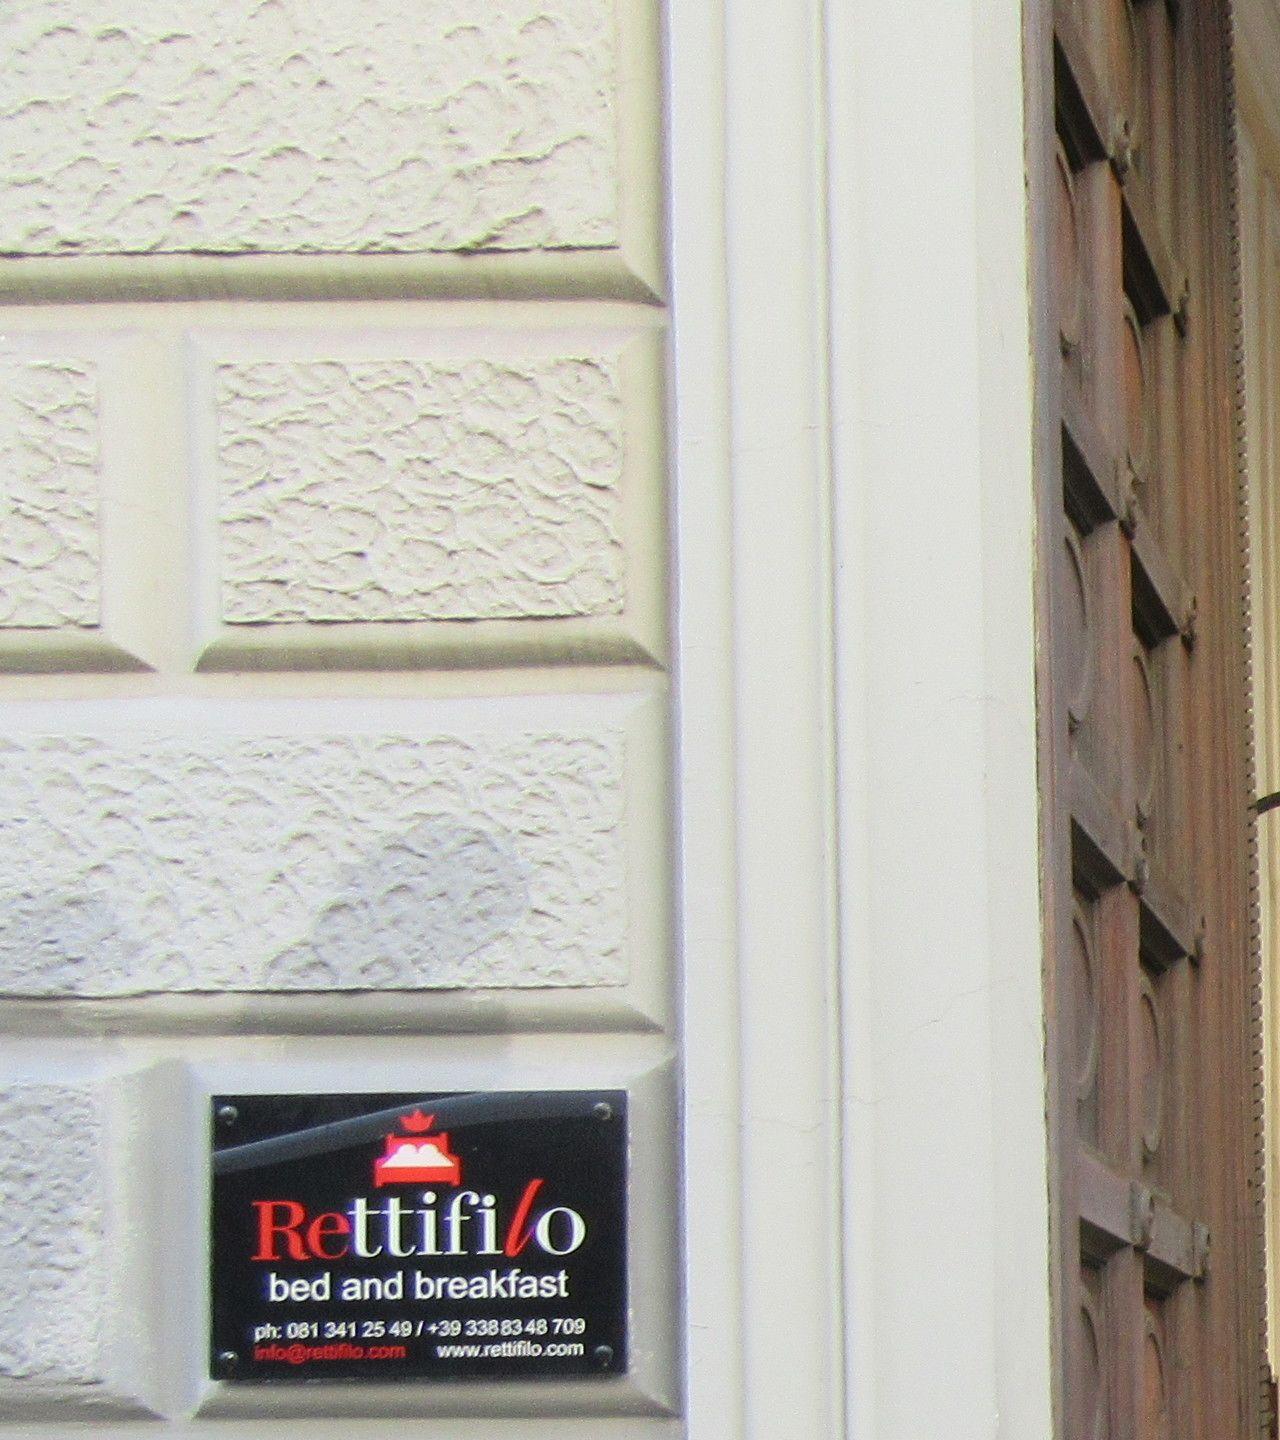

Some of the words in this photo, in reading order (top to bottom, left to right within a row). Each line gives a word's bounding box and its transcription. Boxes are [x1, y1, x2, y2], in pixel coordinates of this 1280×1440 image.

[250, 1178, 586, 1261] Rettifilo
[269, 1271, 331, 1302] bed
[342, 1270, 403, 1301] and
[414, 1268, 569, 1300] breakfast
[254, 1322, 283, 1343] ph:
[324, 1321, 357, 1339] 341
[362, 1320, 385, 1338] 25
[388, 1320, 412, 1338] 49
[427, 1319, 462, 1337] +39
[552, 1317, 586, 1335] 709
[437, 1340, 585, 1358] www.rettifilo.com
